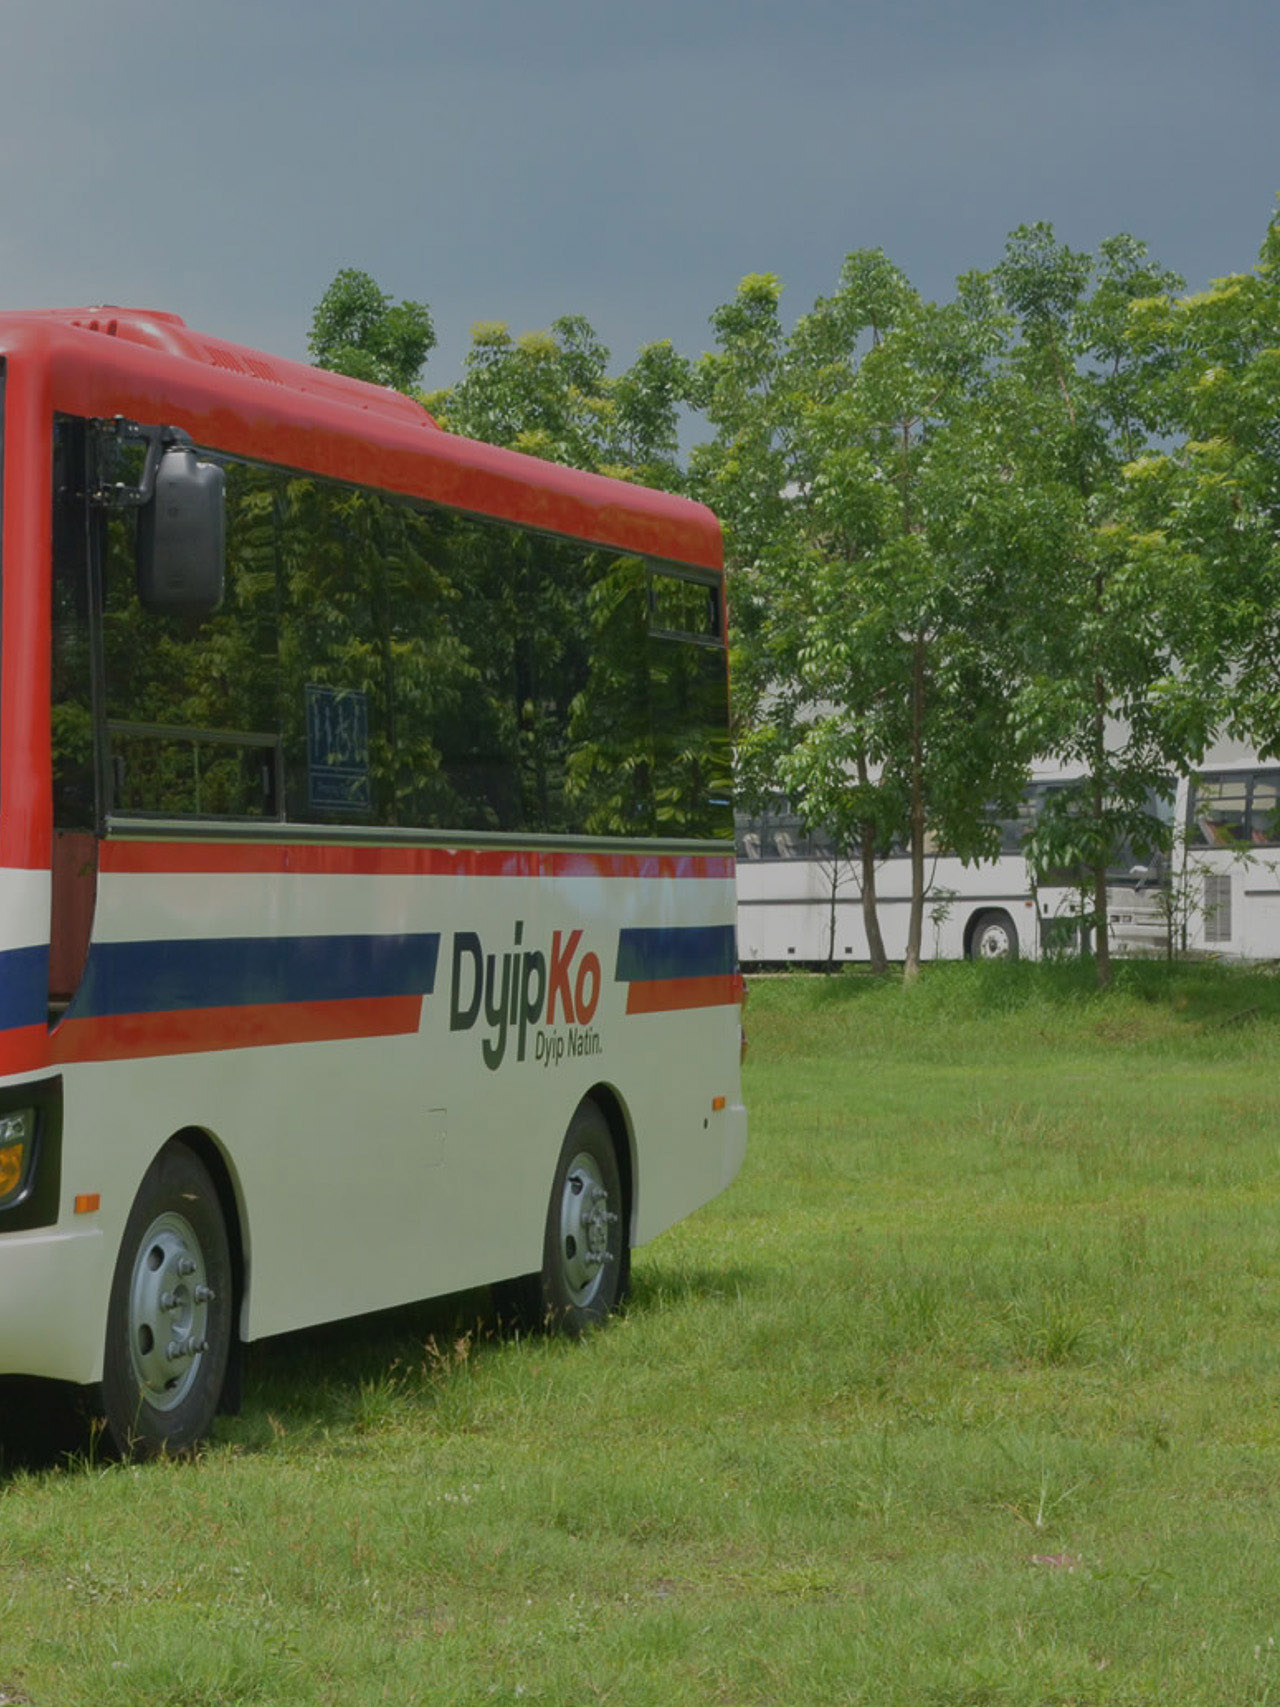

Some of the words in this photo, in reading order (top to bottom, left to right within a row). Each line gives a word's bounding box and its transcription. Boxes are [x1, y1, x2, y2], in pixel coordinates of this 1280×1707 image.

[450, 920, 602, 1072] DyipKo
[535, 1030, 564, 1068] Dyip
[567, 1027, 603, 1058] Natin.
